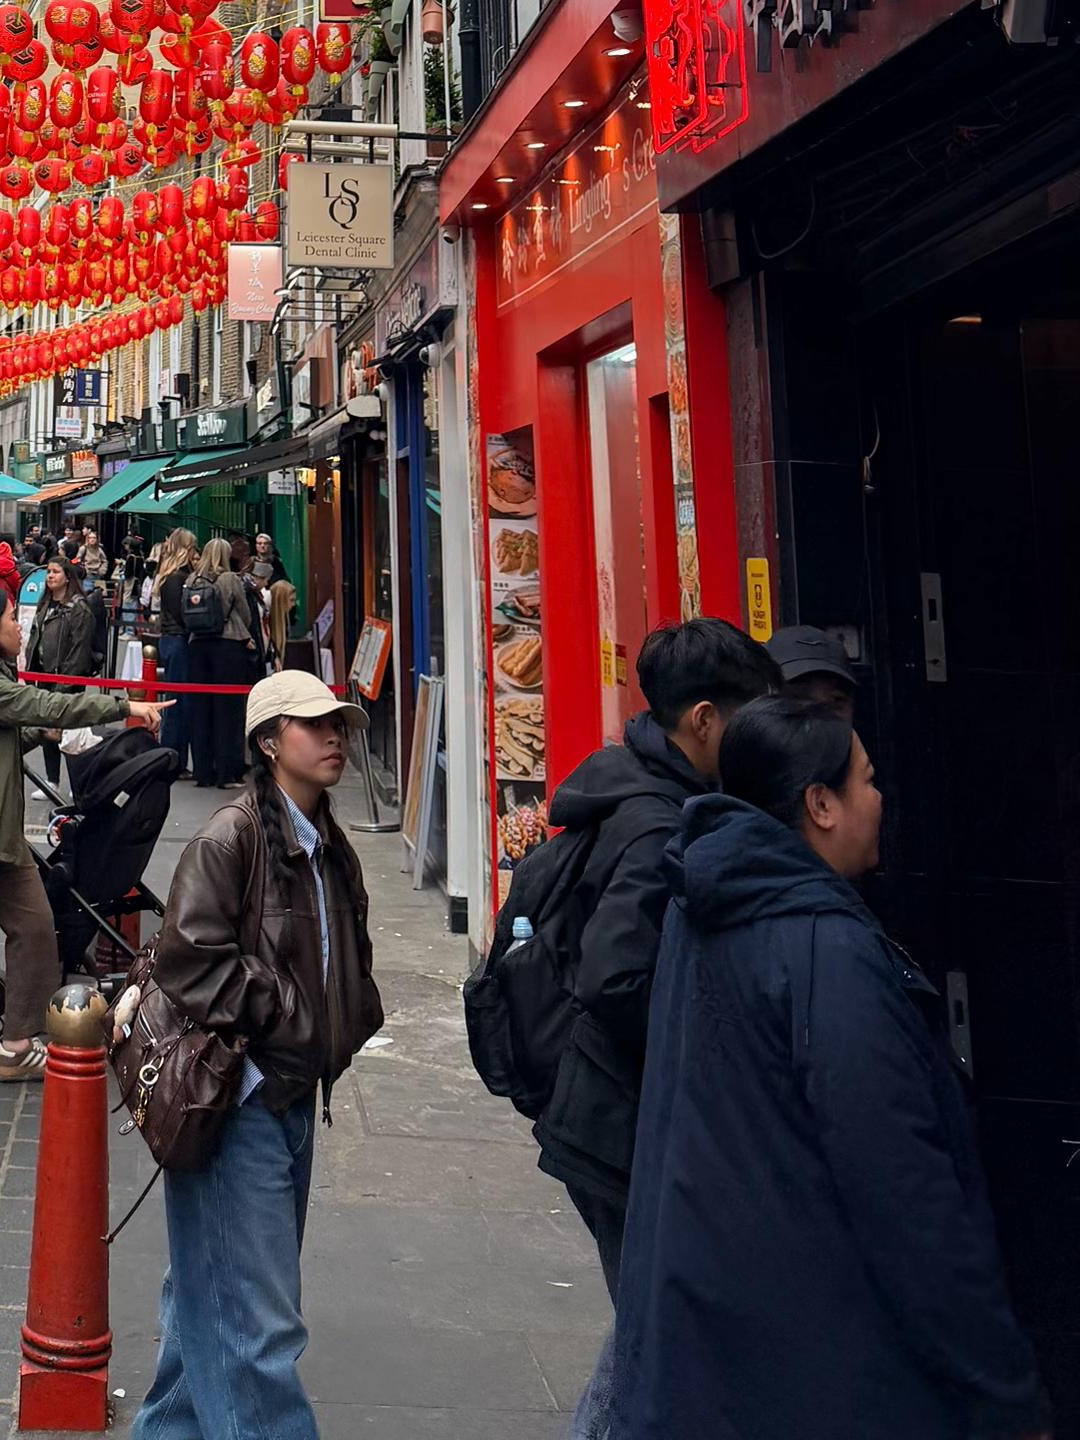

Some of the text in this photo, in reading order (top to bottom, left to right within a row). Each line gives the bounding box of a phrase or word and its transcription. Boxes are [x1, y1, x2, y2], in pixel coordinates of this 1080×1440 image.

[296, 231, 386, 247] Leicester Square
[305, 245, 377, 259] Dental Clinic
